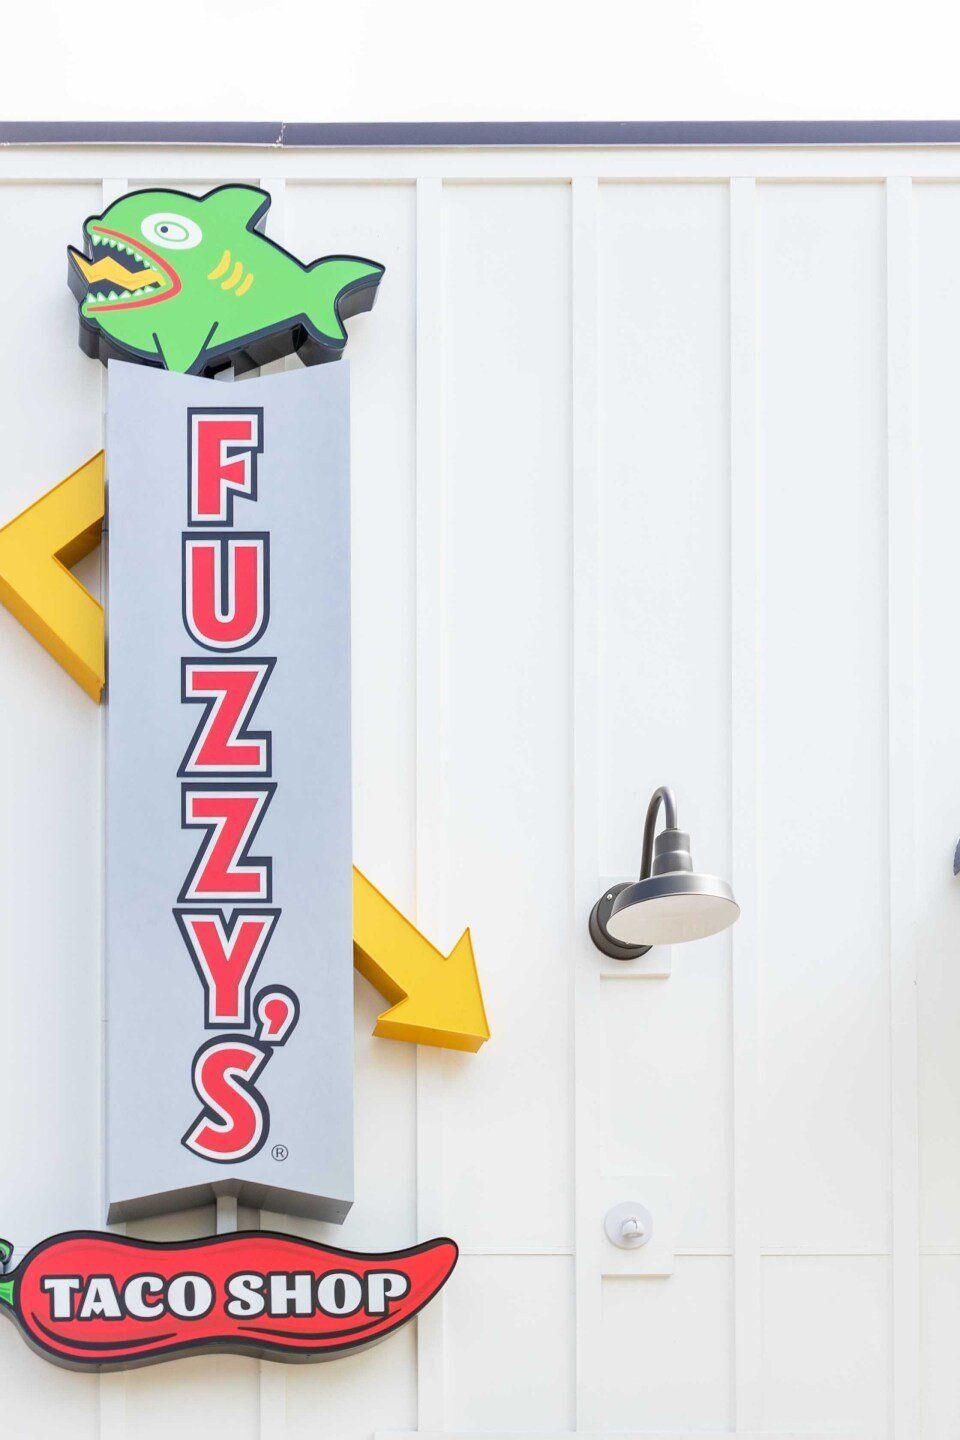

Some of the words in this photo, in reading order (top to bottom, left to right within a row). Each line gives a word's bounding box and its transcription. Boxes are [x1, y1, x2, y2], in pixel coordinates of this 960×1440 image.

[172, 406, 300, 1165] FUZZY'S
[42, 1274, 216, 1320] TACO
[226, 1269, 410, 1318] SHOP
